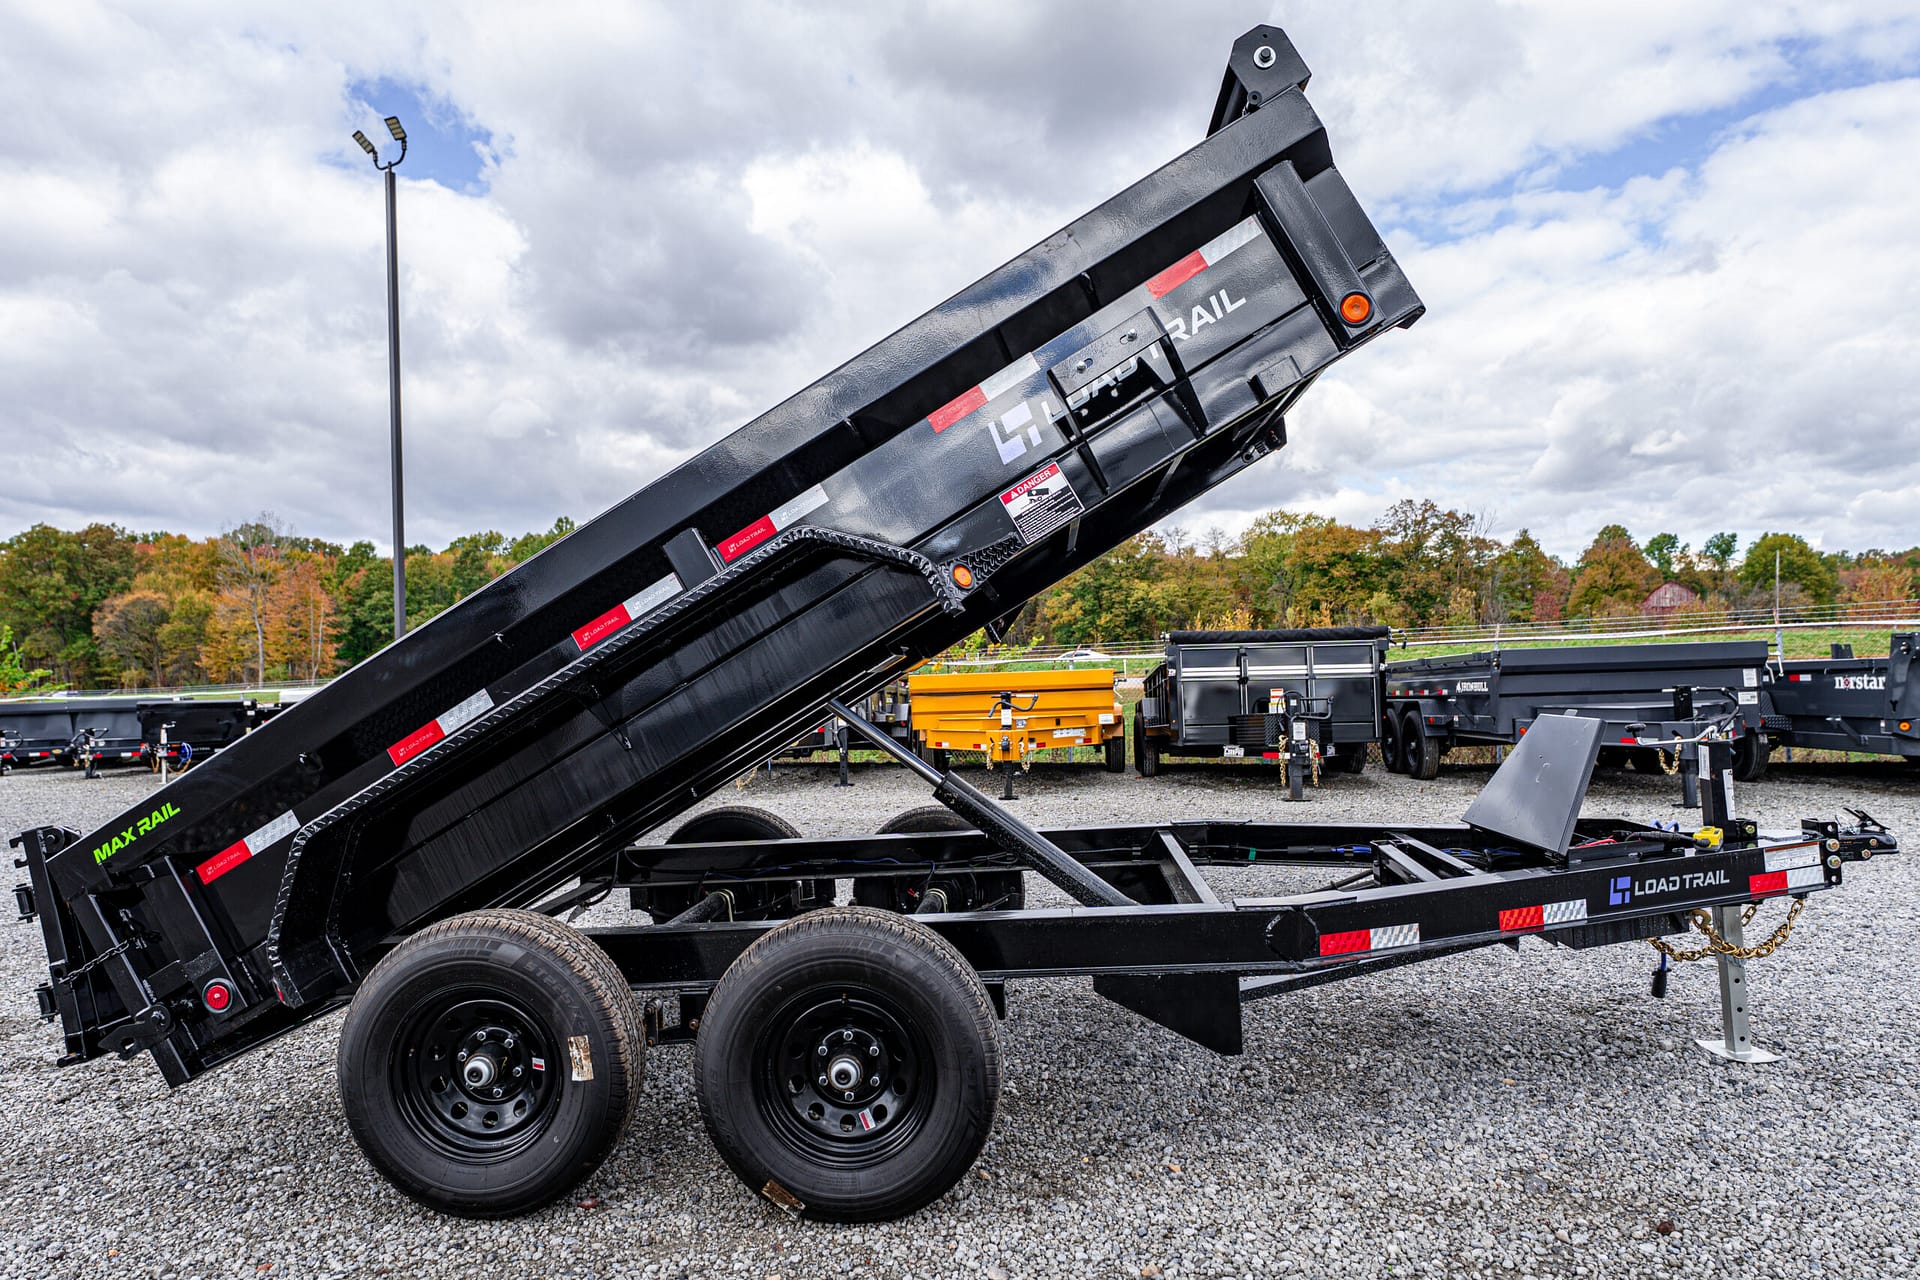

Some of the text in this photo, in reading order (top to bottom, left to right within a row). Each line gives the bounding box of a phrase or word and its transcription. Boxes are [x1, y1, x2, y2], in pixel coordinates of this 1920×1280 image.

[1016, 469, 1052, 495] DANGER
[93, 802, 181, 865] MAX RAIL
[1634, 869, 1730, 896] LOAD TRAIL
